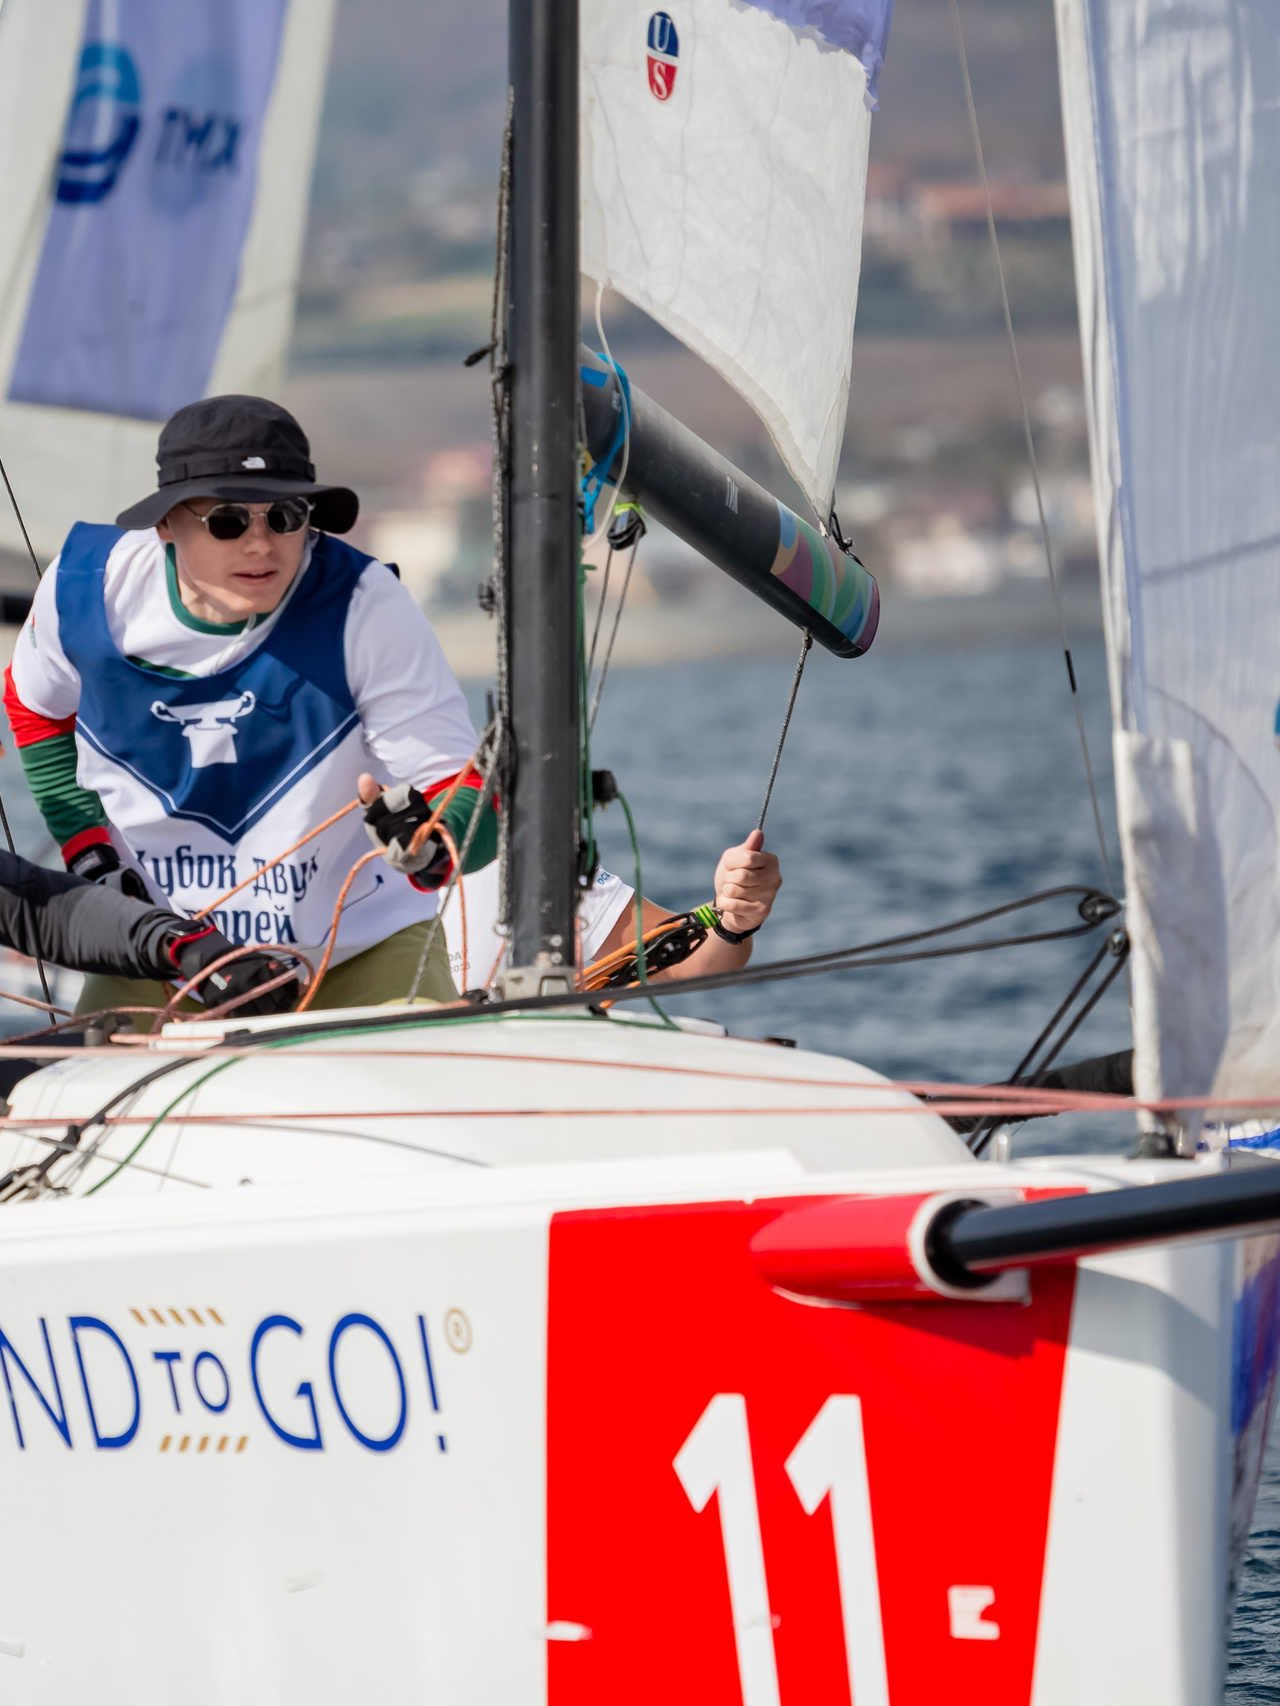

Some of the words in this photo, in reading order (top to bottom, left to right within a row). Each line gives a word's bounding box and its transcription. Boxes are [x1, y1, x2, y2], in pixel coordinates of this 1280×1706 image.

[135, 845, 237, 897] убок
[184, 905, 299, 946] орей
[153, 1350, 231, 1414] TO
[250, 1312, 447, 1454] GO!
[671, 1392, 891, 1706] 11
